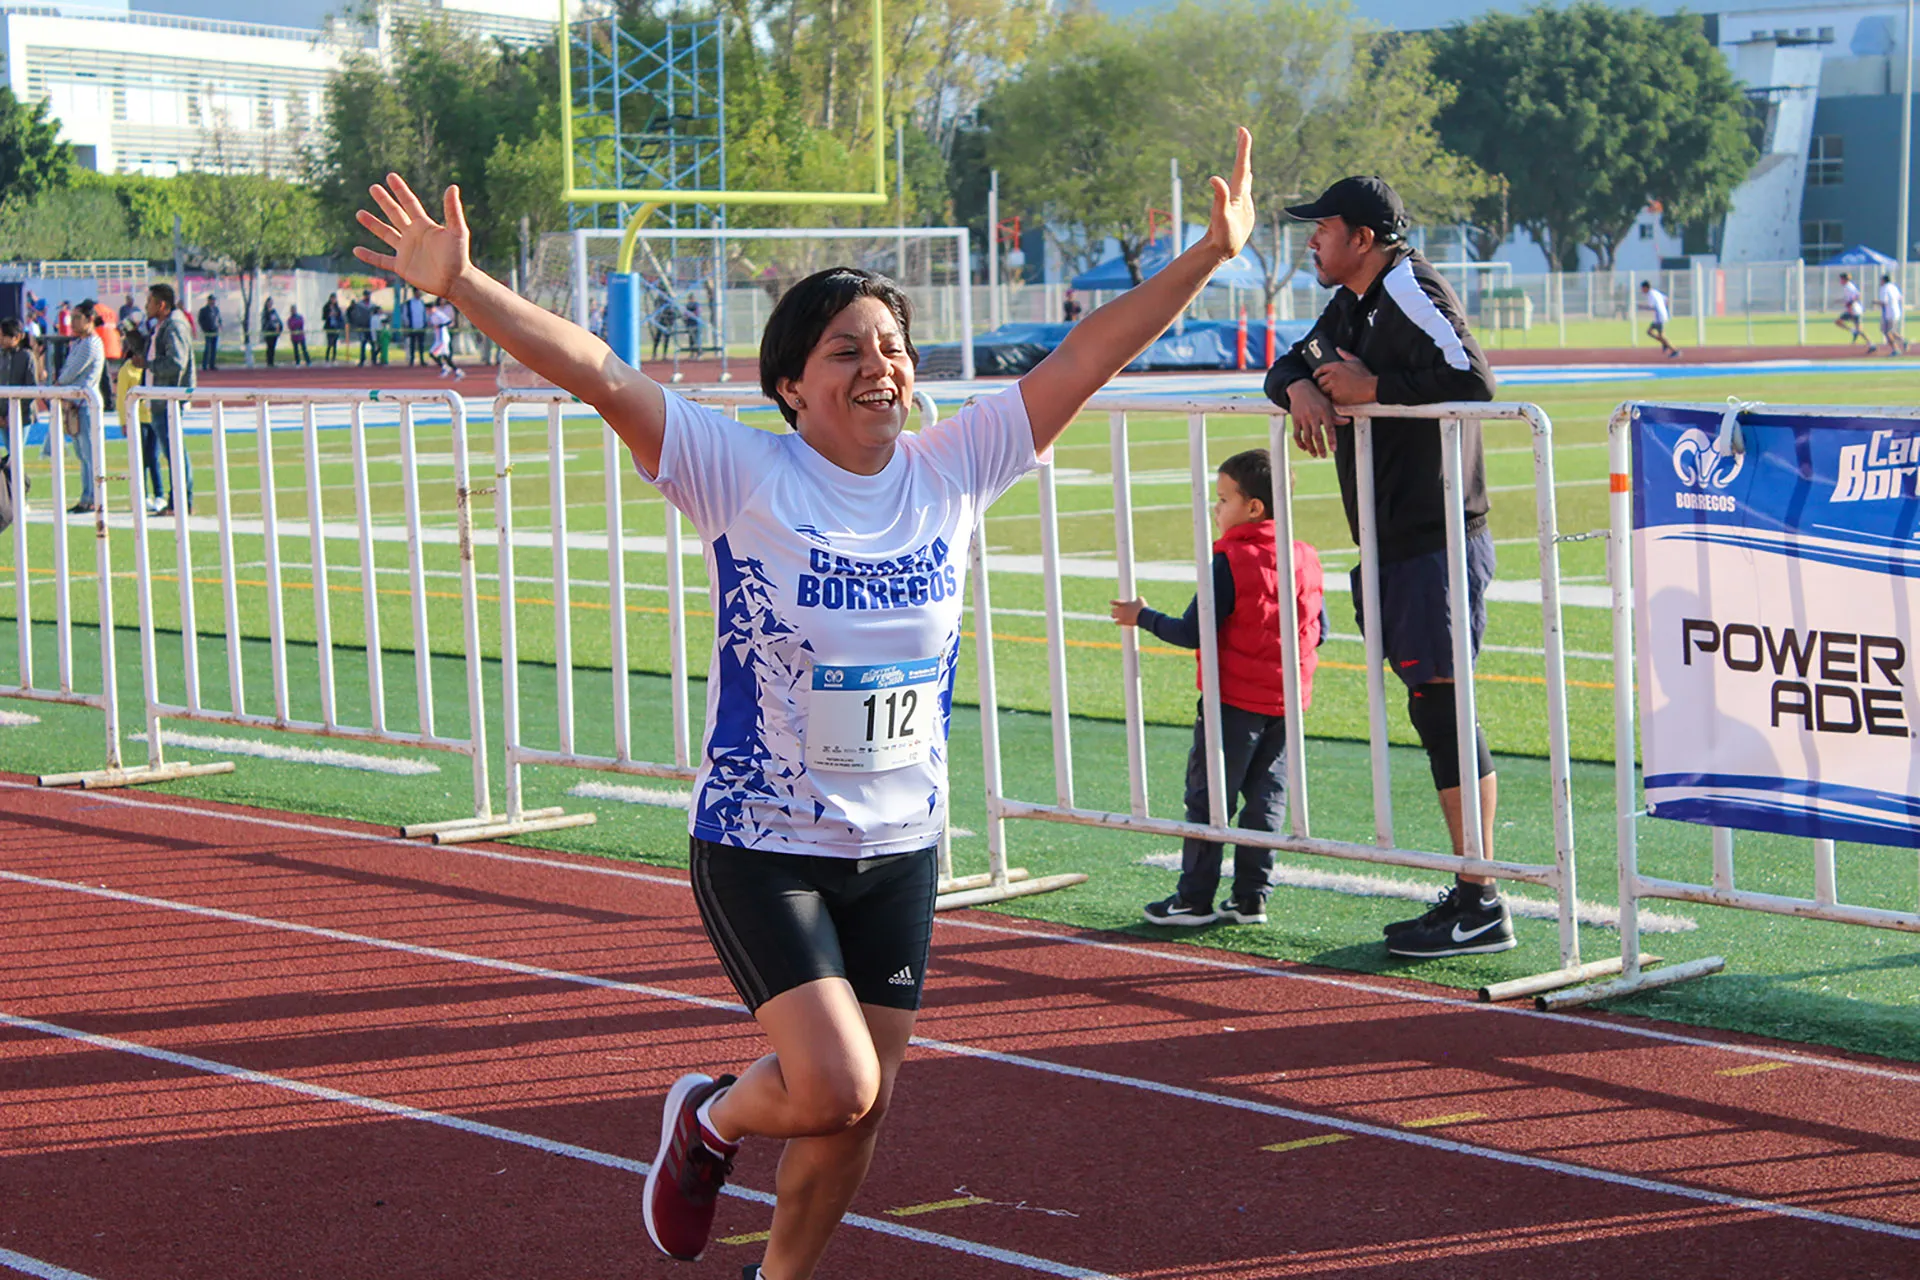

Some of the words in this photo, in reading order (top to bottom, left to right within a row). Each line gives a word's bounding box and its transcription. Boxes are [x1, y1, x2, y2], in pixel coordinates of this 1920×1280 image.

[1829, 444, 1920, 503] Bor
[1675, 492, 1736, 512] BORREGOS
[797, 564, 957, 610] BORREGOS
[1682, 618, 1906, 687] POWER
[863, 689, 918, 742] 112
[1771, 680, 1910, 737] ADE
[888, 977, 915, 985] adidas
